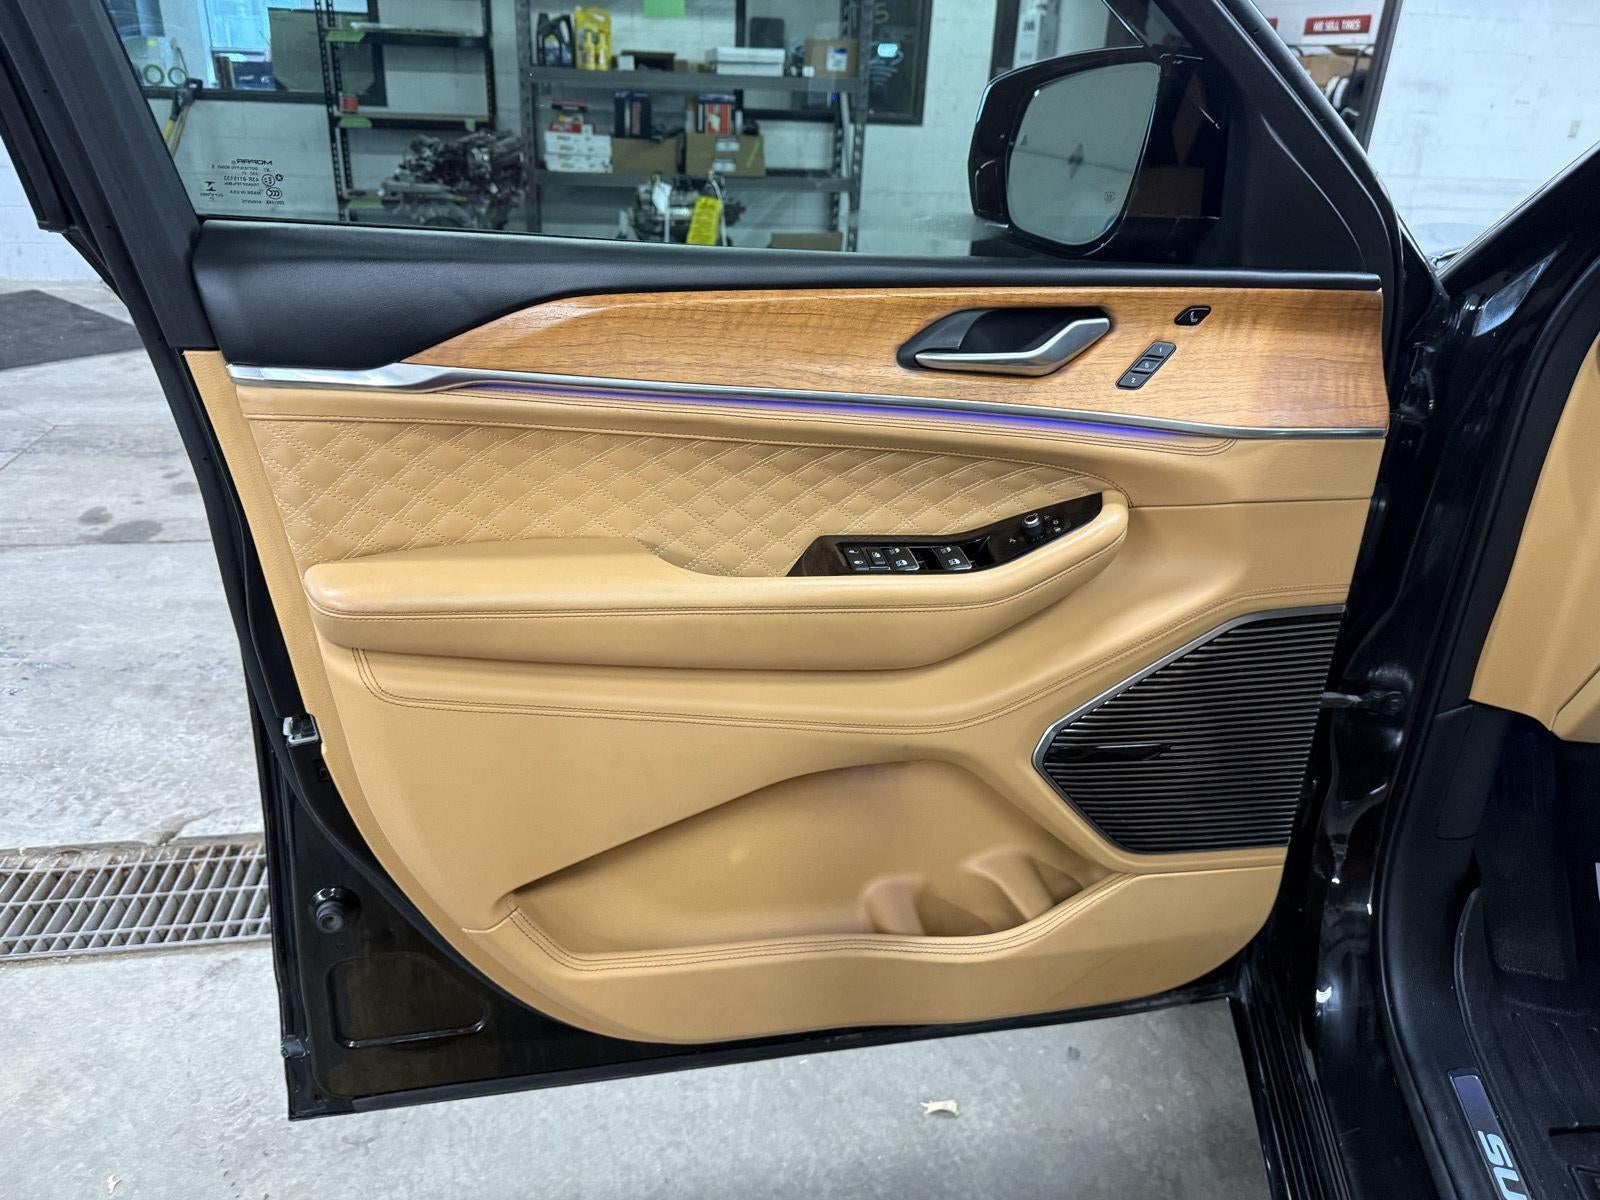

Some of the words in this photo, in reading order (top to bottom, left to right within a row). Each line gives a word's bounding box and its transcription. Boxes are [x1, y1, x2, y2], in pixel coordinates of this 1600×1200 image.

[1312, 20, 1324, 31] WE
[1325, 19, 1340, 31] SELL
[1341, 18, 1361, 31] TIRES
